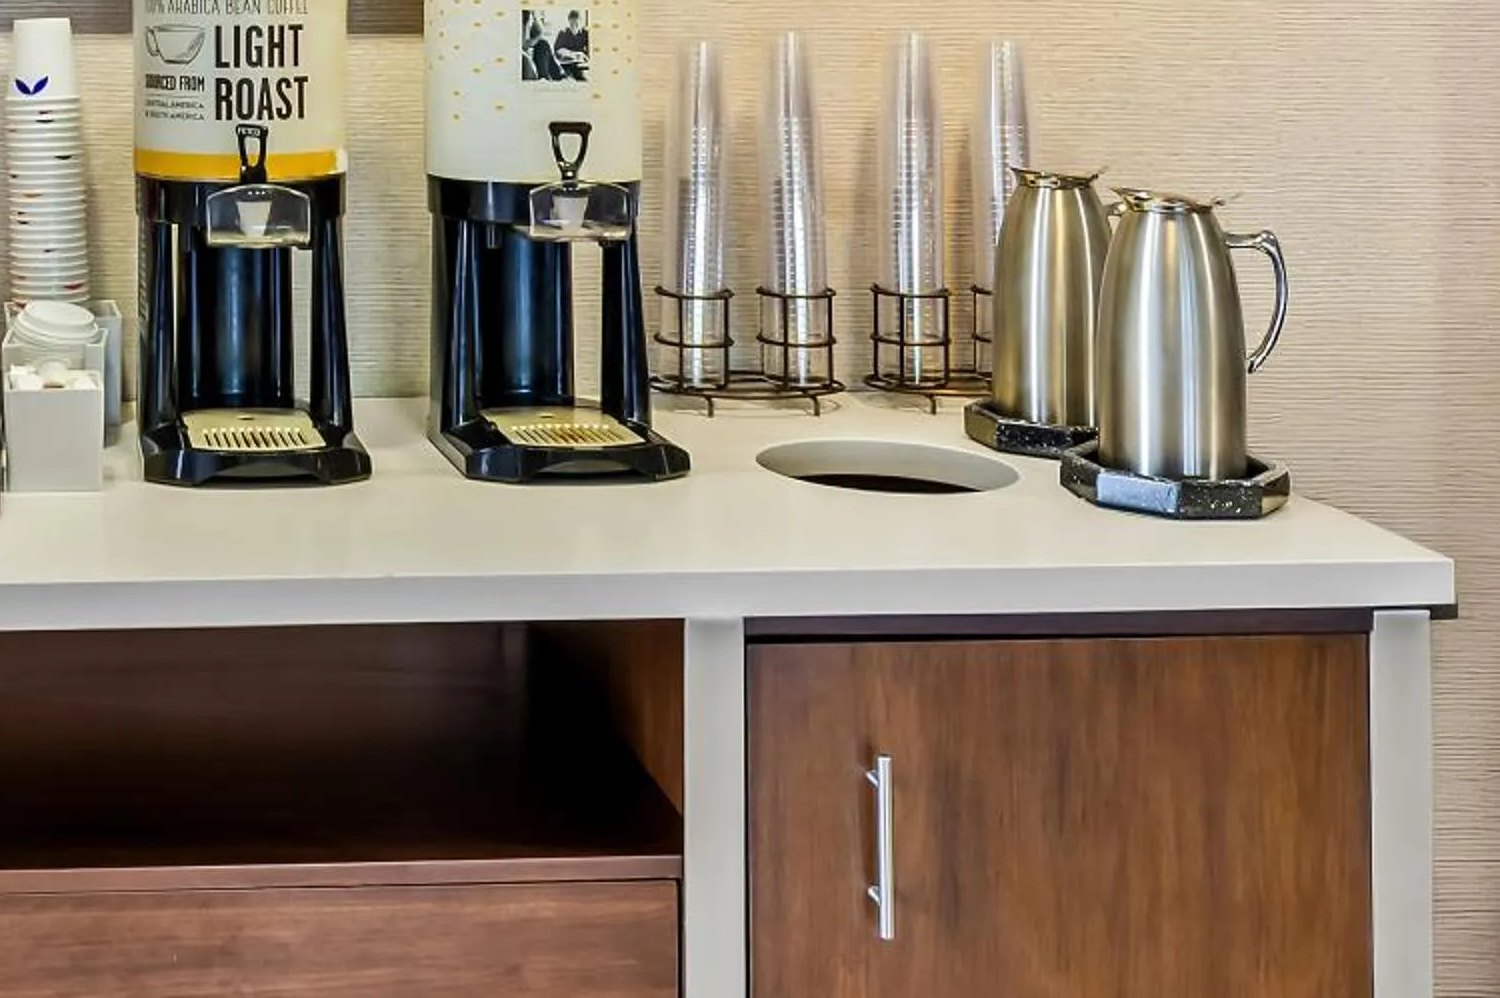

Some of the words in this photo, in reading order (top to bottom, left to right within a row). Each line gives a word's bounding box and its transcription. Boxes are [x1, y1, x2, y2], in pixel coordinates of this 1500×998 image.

[214, 23, 304, 69] LIGHT
[179, 75, 205, 92] FROM
[214, 76, 309, 122] ROAST
